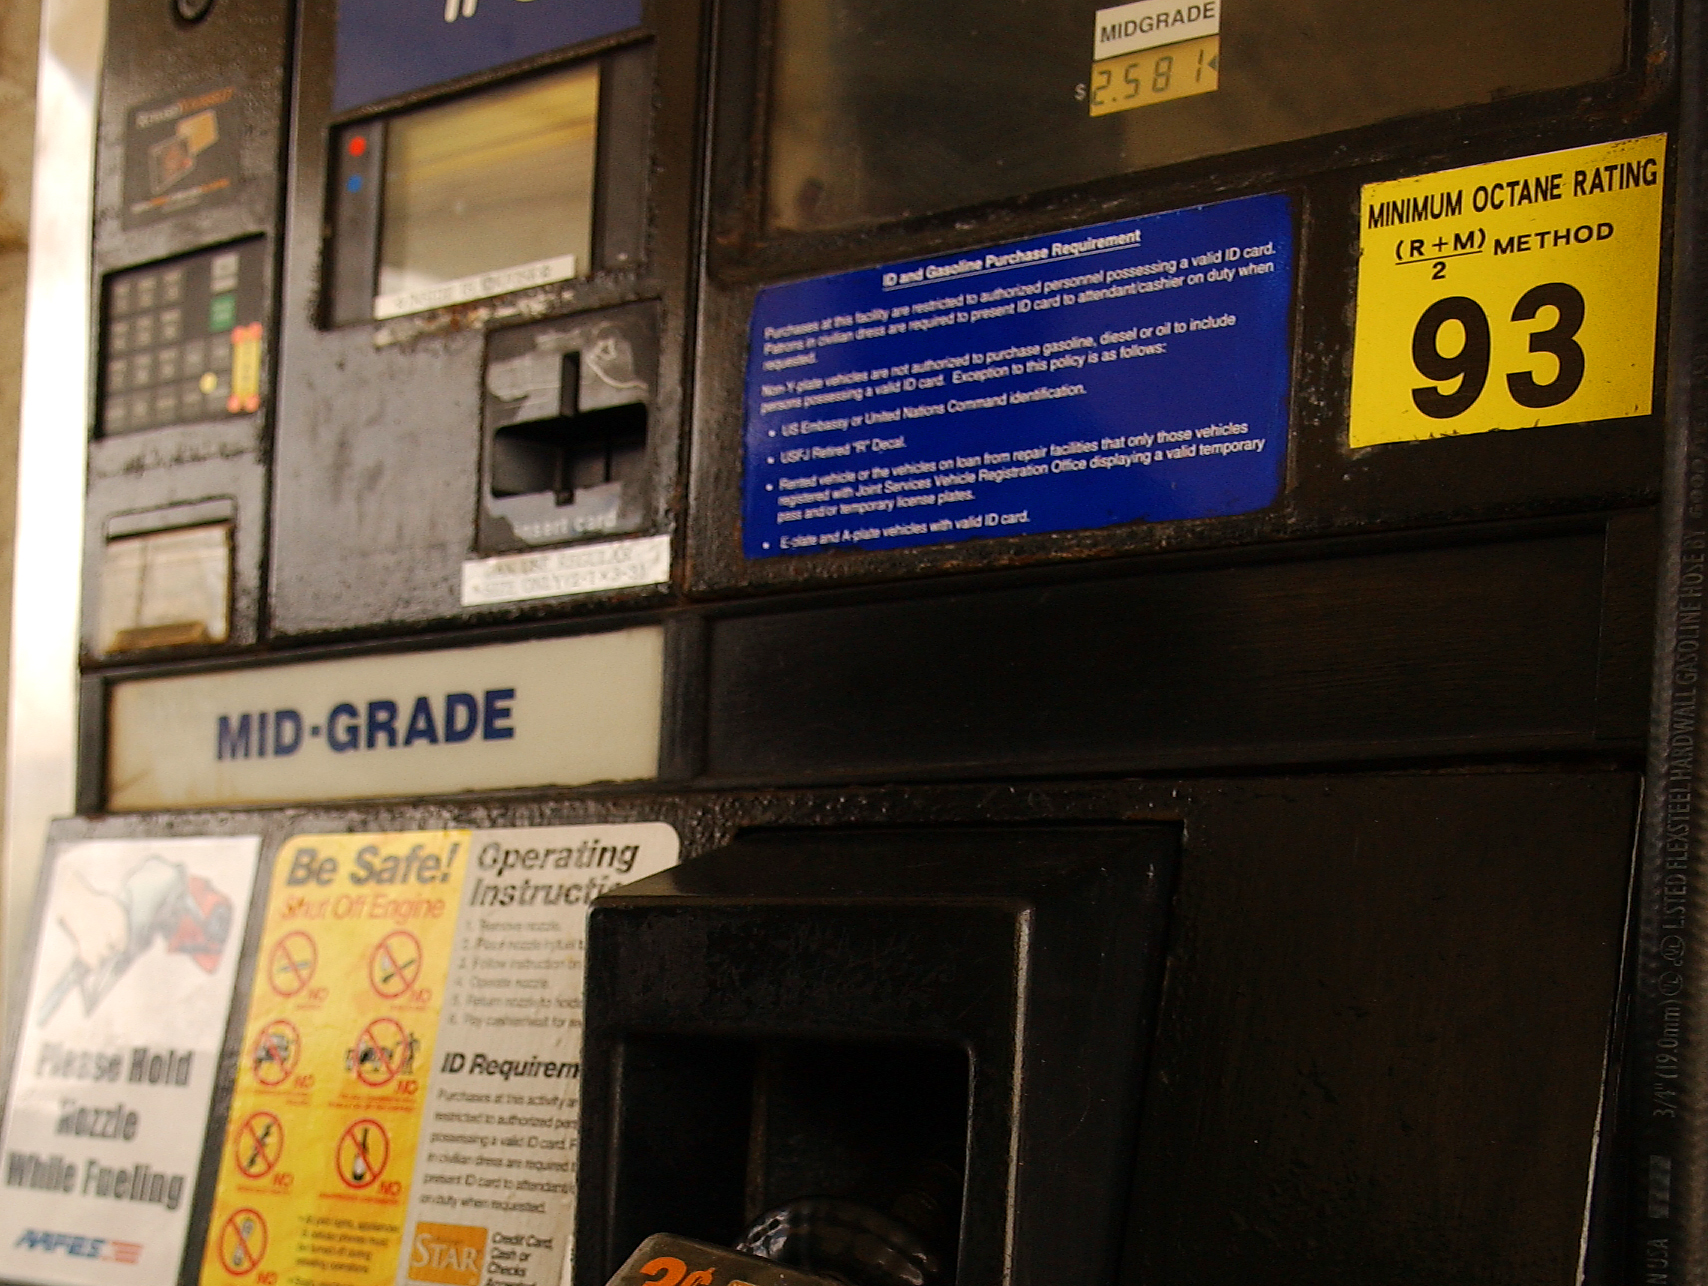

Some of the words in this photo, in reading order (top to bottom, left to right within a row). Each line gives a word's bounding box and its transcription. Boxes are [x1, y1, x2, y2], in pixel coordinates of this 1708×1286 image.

[1100, 1, 1216, 43] MIDGRADE
[1074, 83, 1087, 101] $
[1367, 189, 1464, 230] MINIMUM
[1471, 173, 1563, 213] OCTANE
[1573, 157, 1658, 198] RATING
[881, 271, 898, 288] ID
[898, 266, 925, 285] and
[924, 258, 984, 280] Gasoline
[984, 246, 1050, 270] Purchase
[1050, 228, 1142, 258] Requirement
[1493, 221, 1615, 256] METHOD
[1042, 269, 1105, 295] personnel
[1105, 259, 1178, 285] possessing
[1178, 257, 1189, 270] a
[1190, 249, 1223, 267] valid
[1224, 246, 1241, 262] ID
[1242, 240, 1277, 259] card.
[1061, 293, 1076, 306] to
[1076, 275, 1186, 304] attendant/cashier
[1186, 272, 1205, 286] on
[1206, 266, 1237, 283] duty
[1237, 260, 1275, 277] when
[1431, 261, 1447, 281] 2
[1041, 335, 1098, 356] gasoline,
[1098, 326, 1138, 346] diesel
[1138, 326, 1154, 339] or
[1154, 321, 1172, 337] oil
[1172, 320, 1188, 334] to
[1188, 312, 1237, 332] include
[1410, 281, 1586, 420] 93
[1048, 354, 1087, 373] policy
[1086, 350, 1100, 364] is
[1100, 349, 1118, 362] as
[1118, 342, 1167, 359] follows:
[1049, 439, 1099, 457] facilities
[1100, 435, 1126, 451] that
[1126, 431, 1155, 448] only
[1155, 428, 1193, 444] those
[1194, 421, 1249, 439] vehicles
[1049, 457, 1088, 474] Office
[1088, 449, 1152, 470] displaying
[1152, 449, 1164, 461] a
[1164, 443, 1197, 460] valid
[1198, 437, 1266, 457] temporary
[1681, 529, 1707, 550] BY
[1678, 554, 1706, 597] HOSE
[1673, 603, 1703, 685] GASOLINE
[216, 687, 517, 762] MID-GRADE
[1667, 689, 1696, 781] HARDWALL
[1664, 783, 1692, 870] FLEXSTEEL
[286, 847, 338, 887] Be
[349, 841, 460, 886] Safe!
[477, 838, 641, 877] Operating
[368, 893, 446, 926] Engine
[1662, 873, 1688, 929] LISTED
[1654, 997, 1682, 1080] (19.0mm)
[128, 1047, 194, 1087] Hold
[441, 1052, 465, 1074] ID
[7, 1152, 77, 1193] While
[82, 1159, 186, 1211] Fueling
[411, 1232, 479, 1274] STAR
[1646, 1237, 1669, 1269] USA
